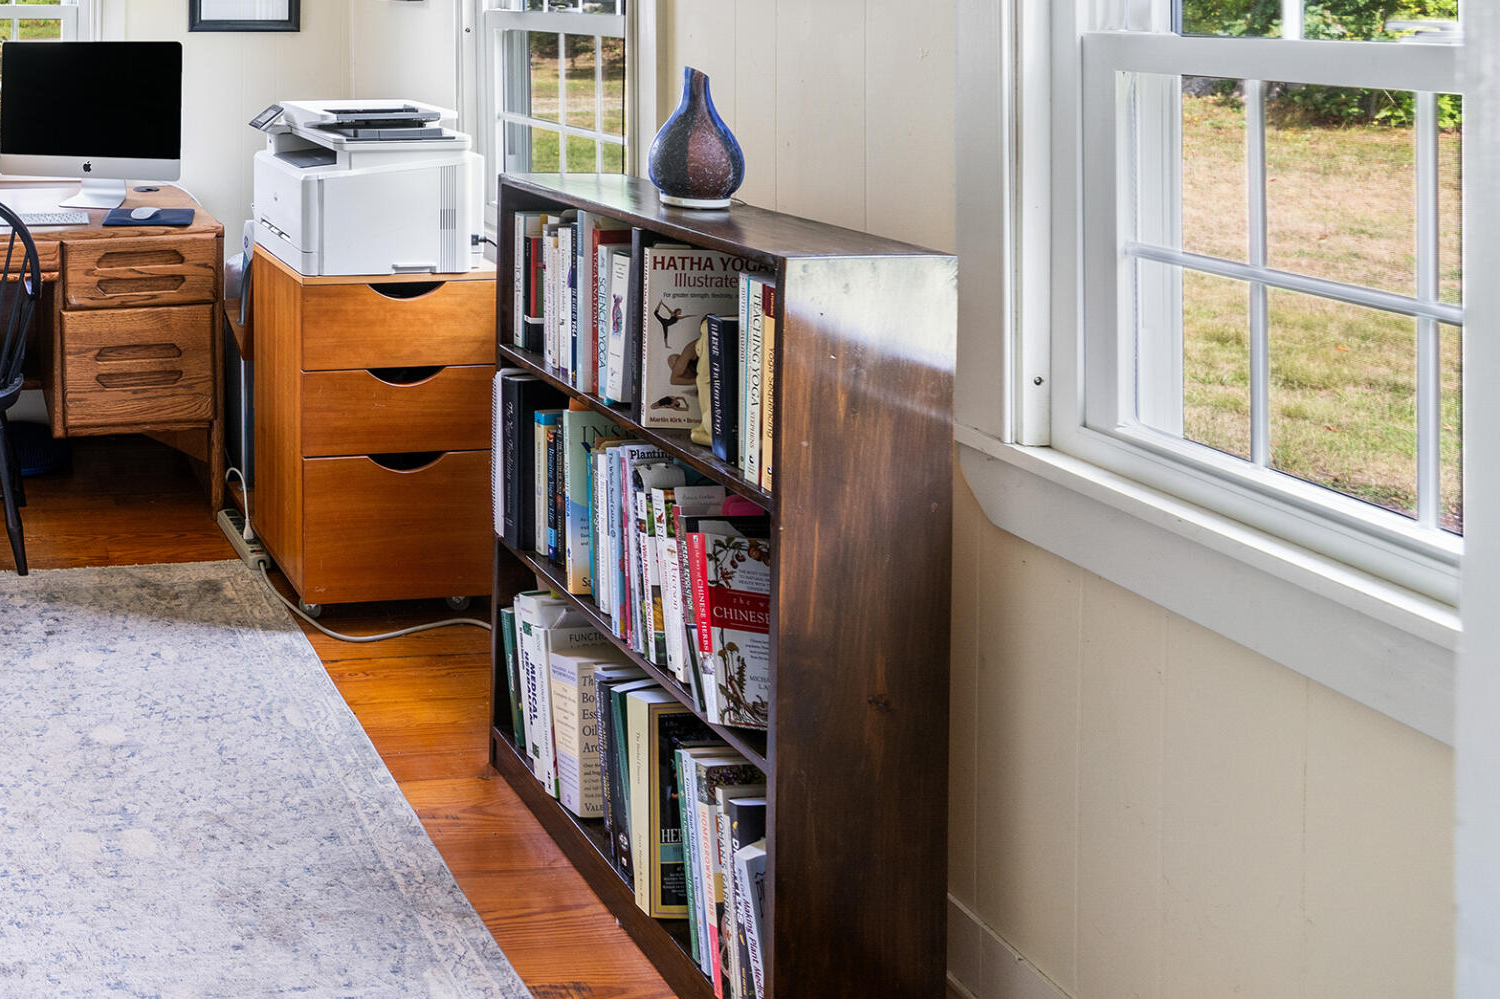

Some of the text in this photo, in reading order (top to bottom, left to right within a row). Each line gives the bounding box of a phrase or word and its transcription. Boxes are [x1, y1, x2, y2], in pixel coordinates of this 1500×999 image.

[652, 255, 771, 272] HATHA YOGA
[673, 273, 739, 288] Illustrate
[597, 276, 607, 369] SCIENCE YOGA
[749, 293, 763, 449] TEACHING YOGA STEPHENS
[505, 400, 514, 417] The
[649, 416, 669, 424] Martin
[505, 439, 514, 480] Tradition
[547, 447, 555, 479] Bringing
[609, 503, 617, 529] Catalog
[641, 544, 649, 562] Wild
[643, 562, 651, 601] Medicine
[680, 540, 693, 611] HERBAL REVOLUTION
[697, 578, 711, 652] CHINESE HERBS
[713, 605, 770, 624] CHINESE
[733, 596, 752, 605] the
[529, 662, 540, 721] MEDICAL
[581, 675, 594, 687] Th
[582, 725, 598, 737] Oil
[700, 810, 715, 918] HOMEGROWN HERBS
[715, 808, 732, 928] WOMAN'S GARDEN
[742, 898, 760, 964] Making Plant
